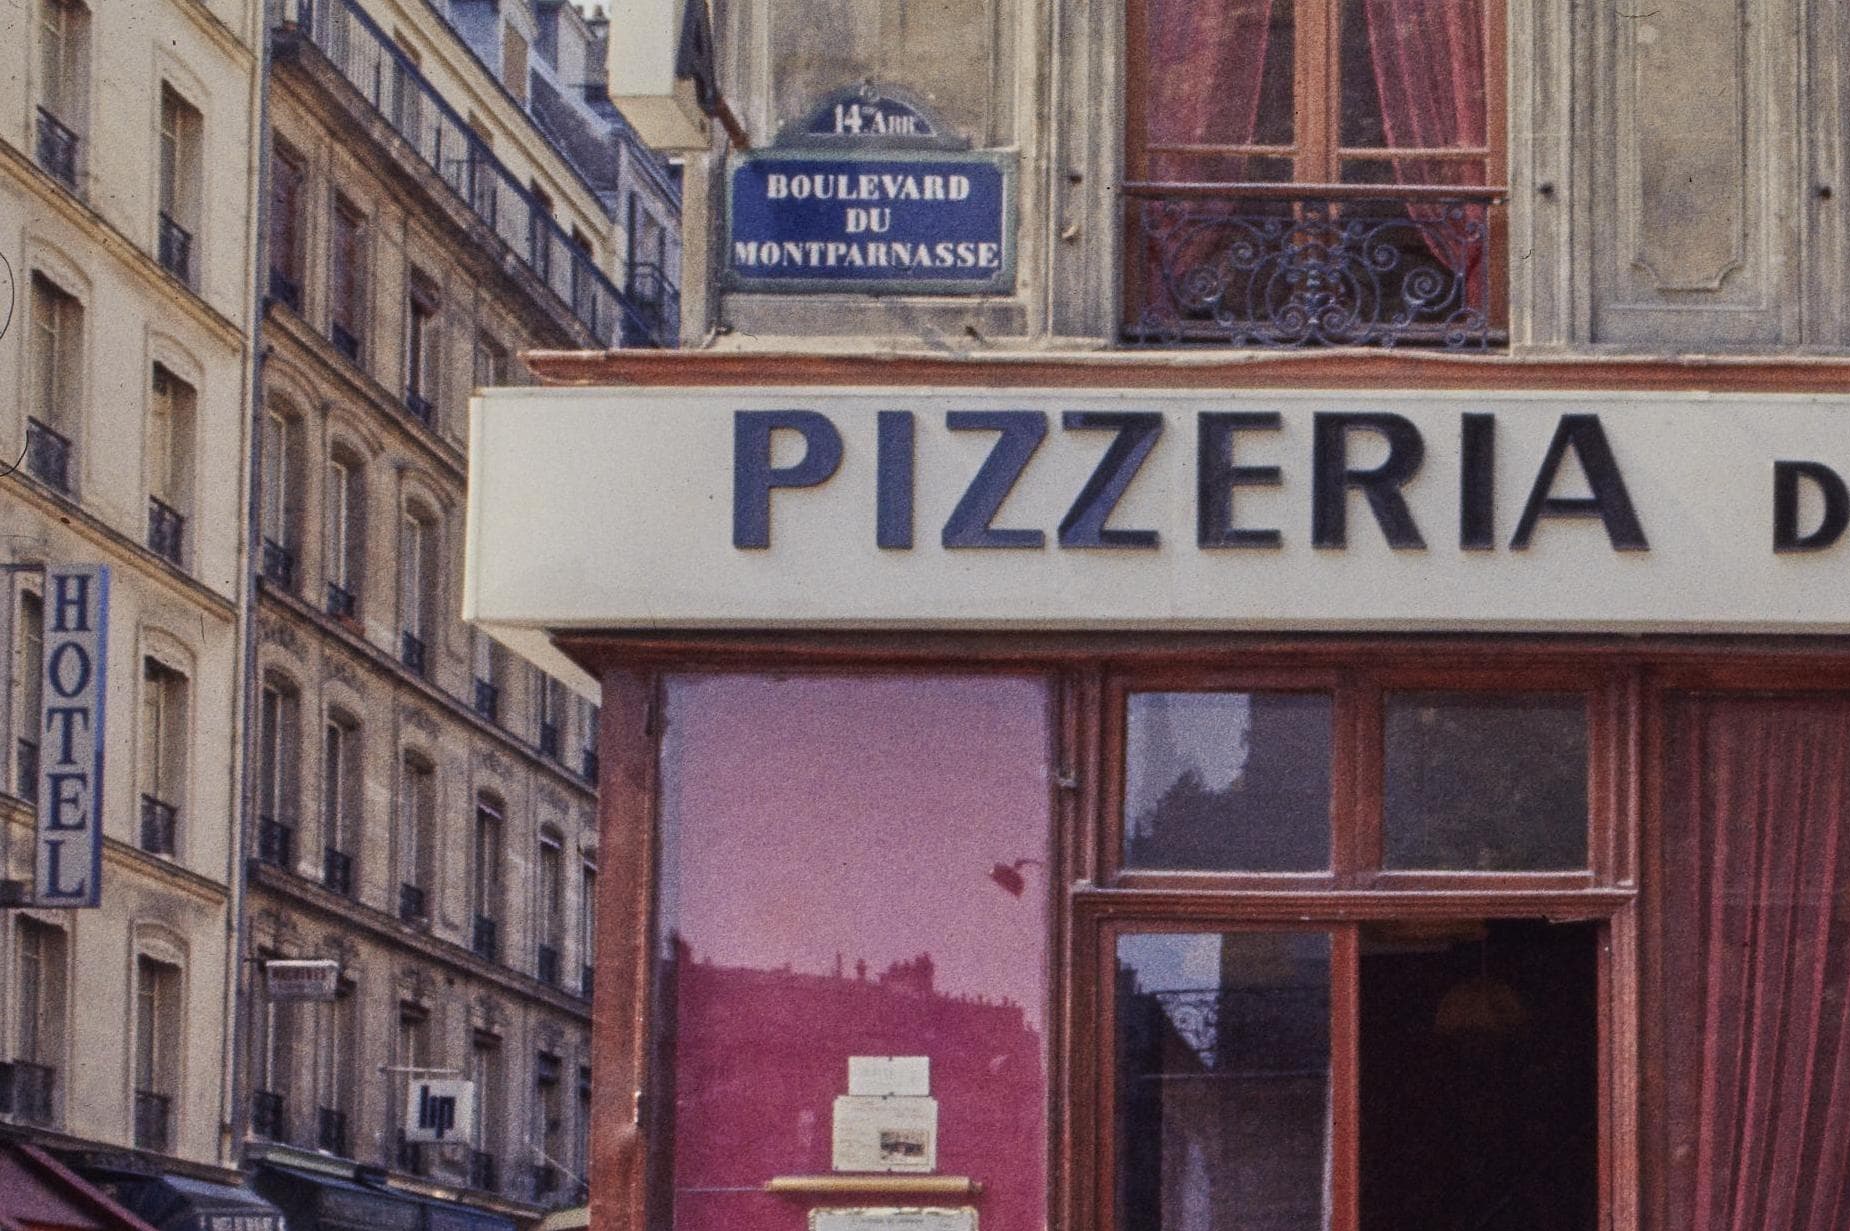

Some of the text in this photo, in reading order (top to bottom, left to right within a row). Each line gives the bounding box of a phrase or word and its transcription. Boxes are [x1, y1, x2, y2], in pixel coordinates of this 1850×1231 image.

[766, 174, 970, 200] BOULEVARD
[846, 207, 892, 233] DU
[734, 241, 999, 268] MONTPARNASSE
[733, 409, 1650, 551] PIZZERIA
[43, 574, 92, 899] HOTEL
